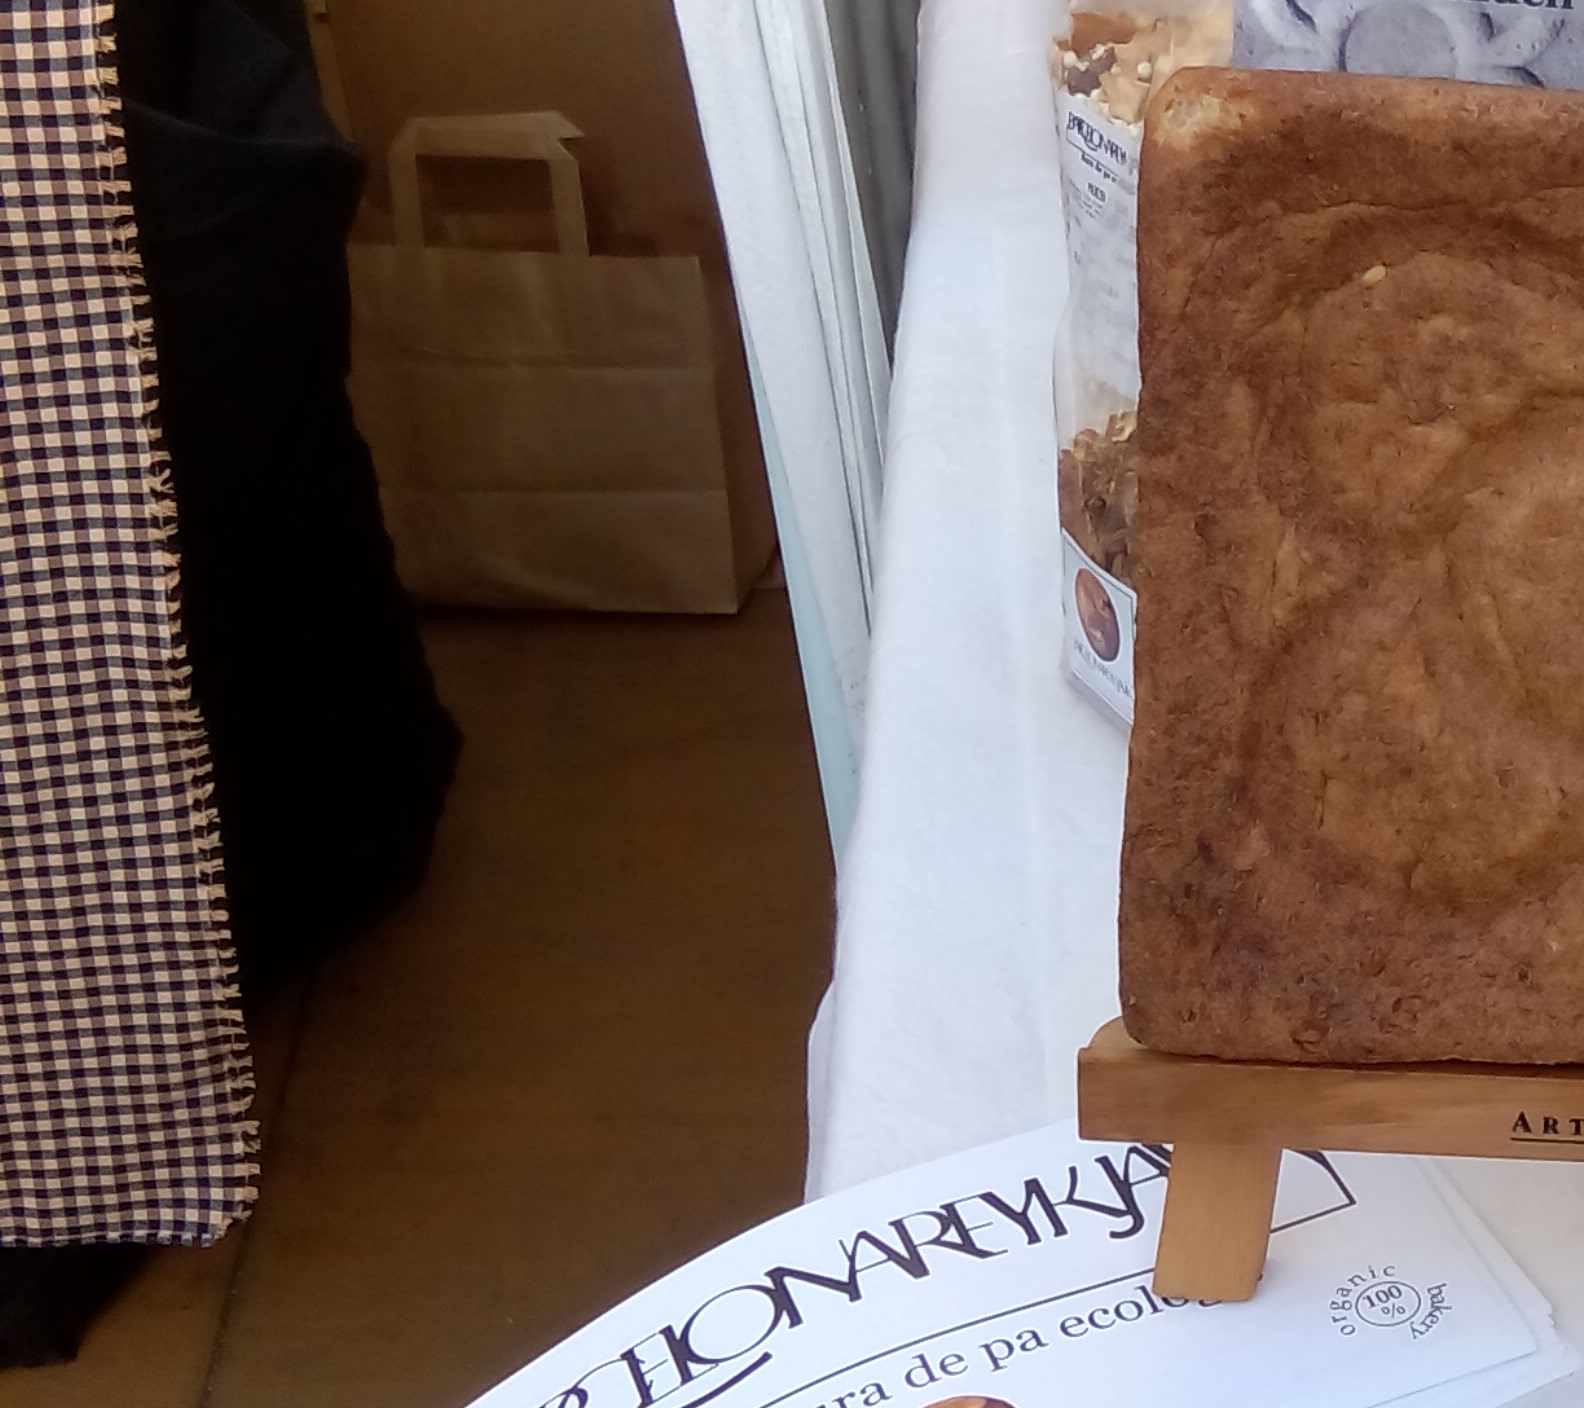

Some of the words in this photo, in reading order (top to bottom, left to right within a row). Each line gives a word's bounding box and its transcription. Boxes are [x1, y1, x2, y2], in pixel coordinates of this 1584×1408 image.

[1329, 1265, 1396, 1336] organic
[1362, 1285, 1403, 1309] 100
[1410, 1282, 1453, 1340] bakery
[903, 1353, 969, 1390] de
[978, 1327, 1050, 1373] pa
